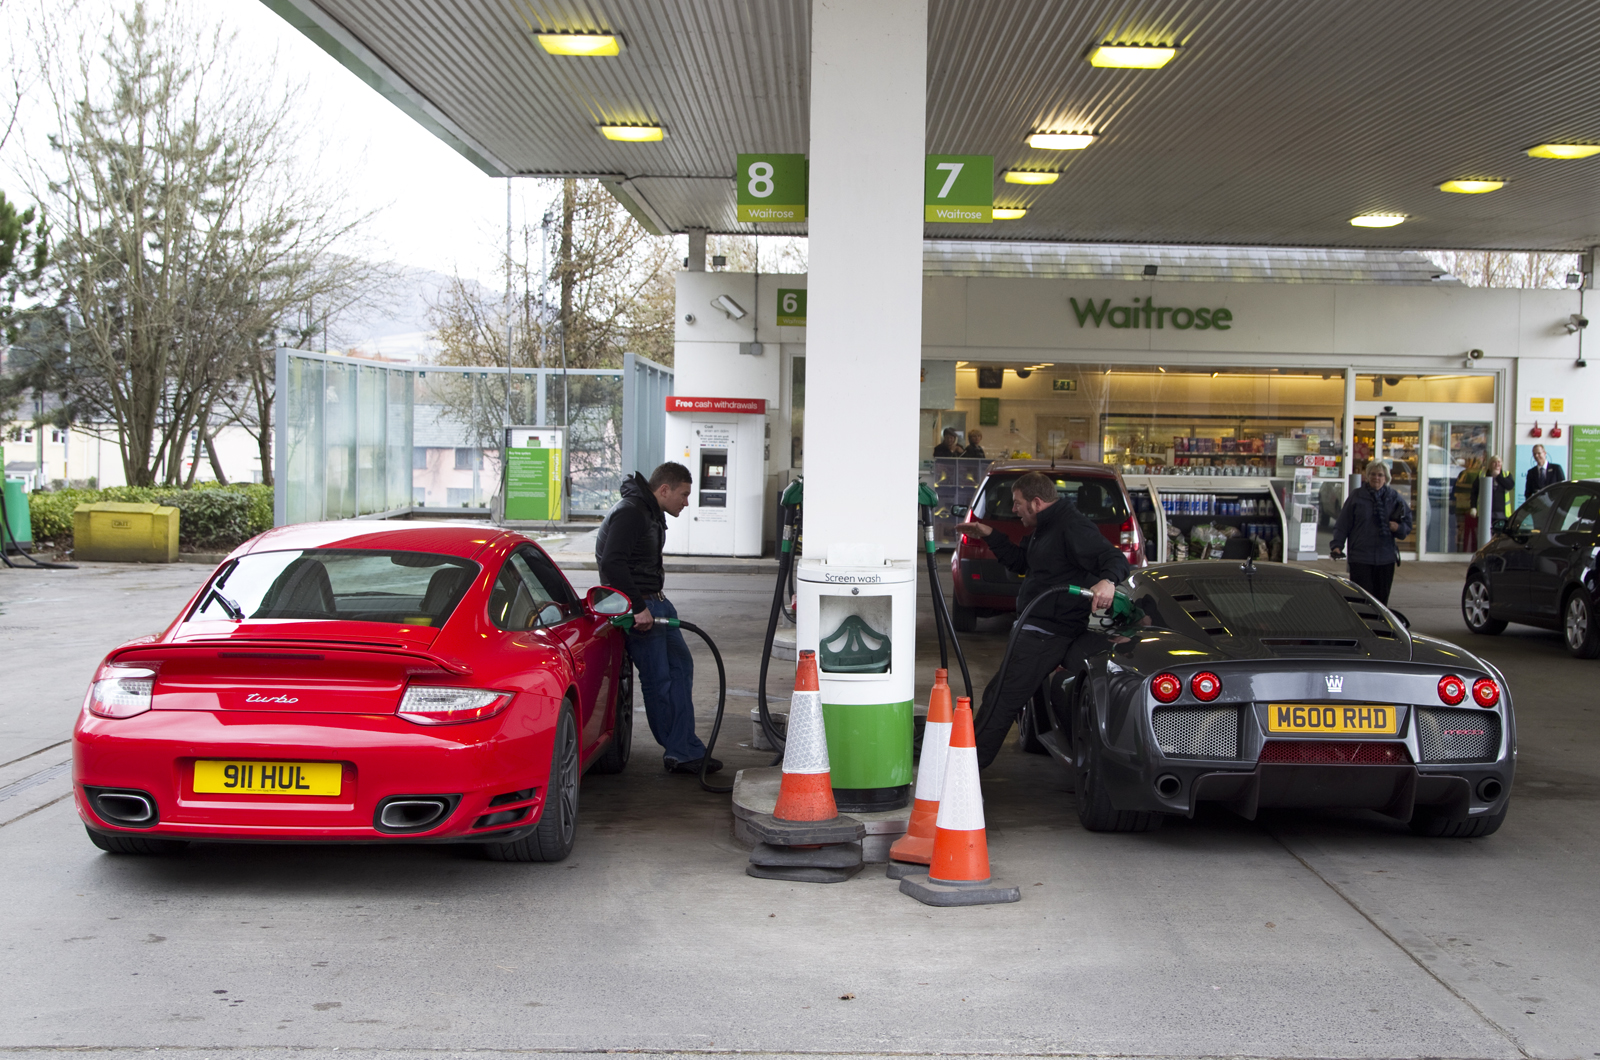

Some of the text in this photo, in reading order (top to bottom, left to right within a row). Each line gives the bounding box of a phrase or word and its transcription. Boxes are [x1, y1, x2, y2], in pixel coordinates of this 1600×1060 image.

[747, 161, 775, 198] 8
[936, 162, 965, 198] 7
[748, 208, 794, 219] Waitrose
[936, 209, 982, 219] Waitrose
[783, 292, 798, 313] 6
[1069, 296, 1233, 330] Waitrose
[675, 399, 758, 410] Free cash withdrawals
[825, 572, 882, 583] Screen wash
[245, 692, 299, 704] turbo
[1277, 706, 1387, 729] M600 RHD
[223, 764, 310, 790] 911 HUL
